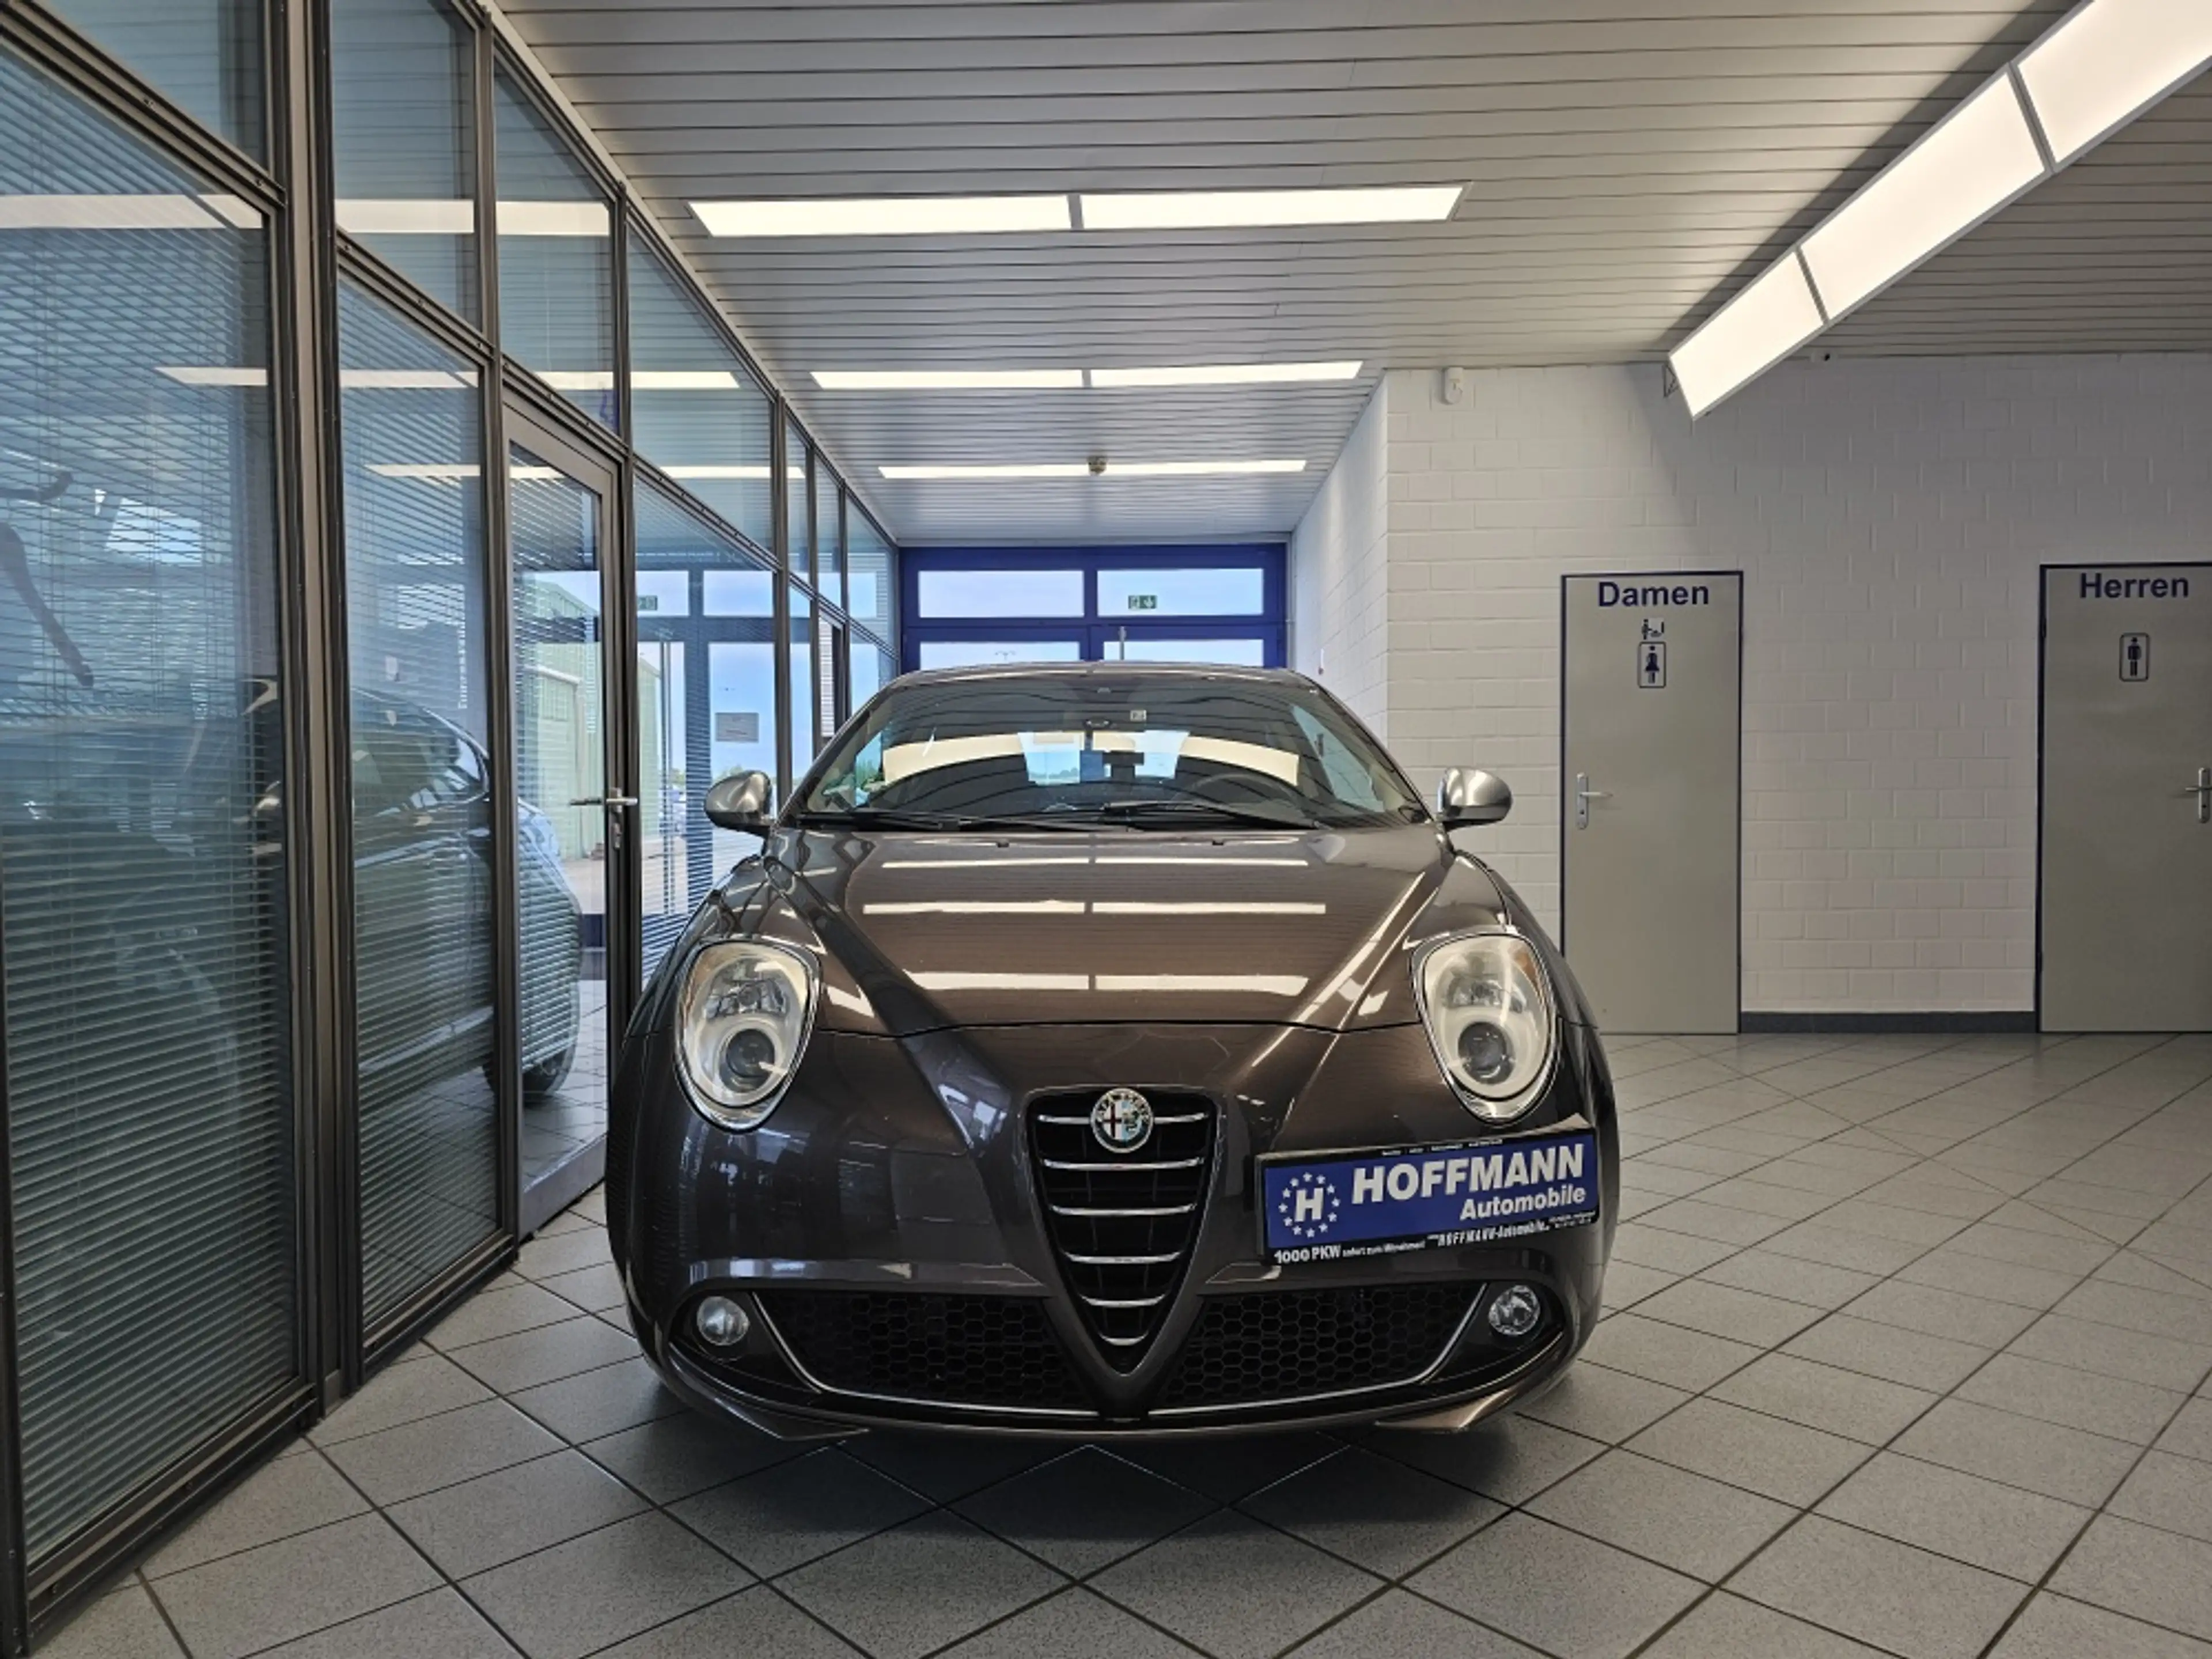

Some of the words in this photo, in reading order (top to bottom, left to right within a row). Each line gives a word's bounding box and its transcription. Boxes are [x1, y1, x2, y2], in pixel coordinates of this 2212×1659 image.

[1598, 581, 1709, 607] Damen
[2080, 572, 2190, 599] Herren
[1351, 1144, 1584, 1204] HOFFMANN
[1294, 1187, 1324, 1222] H
[1460, 1184, 1586, 1220] Automobile
[1274, 1248, 1310, 1264] 1000
[1311, 1244, 1342, 1260] PKW
